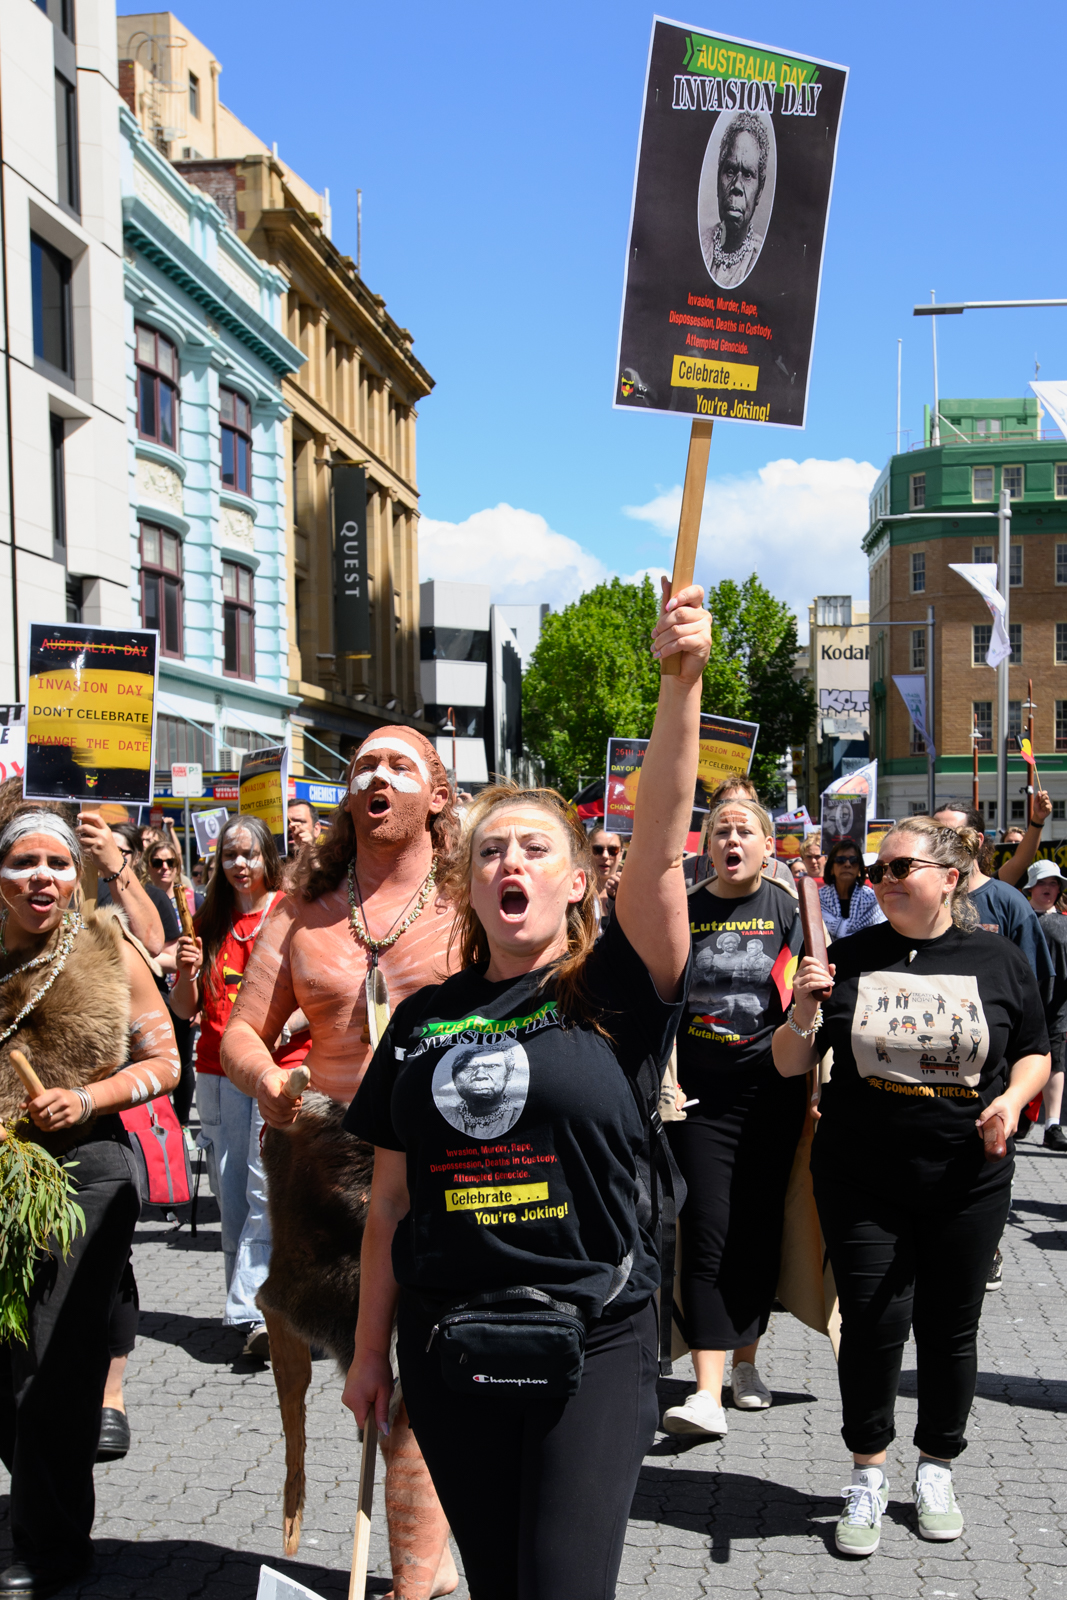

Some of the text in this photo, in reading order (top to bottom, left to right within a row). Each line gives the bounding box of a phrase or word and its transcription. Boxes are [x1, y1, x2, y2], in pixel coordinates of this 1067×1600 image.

[697, 44, 808, 92] AUSTRALIA DAY
[672, 75, 822, 116] INVASION DAY
[687, 292, 758, 318] Invasion, Murder, Rape,
[669, 310, 773, 340] Dispossession, Deaths in Custody,
[685, 333, 749, 354] Attempted Genocide.
[678, 360, 730, 385] Celebrate
[696, 394, 771, 422] You're Joking!
[340, 521, 360, 598] QUEST
[41, 638, 149, 657] AUSTRALIA DAY
[37, 678, 144, 697] INVASION DAY
[33, 705, 74, 718] DON'T
[76, 709, 149, 723] CELEBRATE
[28, 734, 149, 752] CHANGE THE DATE
[731, 750, 746, 759] DAY
[709, 761, 745, 774] CELEBRATE
[242, 781, 265, 794] INVASION
[268, 779, 278, 788] DAY
[309, 785, 336, 802] CHEMIST
[241, 796, 282, 811] DON'T CELEBRATE
[271, 814, 284, 824] DATE
[690, 918, 775, 933] Lutruwita
[434, 1006, 548, 1035] AUSTRALIA DAY
[688, 1026, 741, 1043] Kutalayna
[884, 1081, 935, 1098] COMMON
[446, 1142, 533, 1157] Invasion, Murder, Rape,
[430, 1154, 558, 1173] Dispossession, Deaths in Custody,
[453, 1170, 531, 1183] Attempted Genocide.
[451, 1189, 512, 1206] Celebrate
[475, 1202, 569, 1225] You're Joking!
[472, 1374, 548, 1387] Champion
